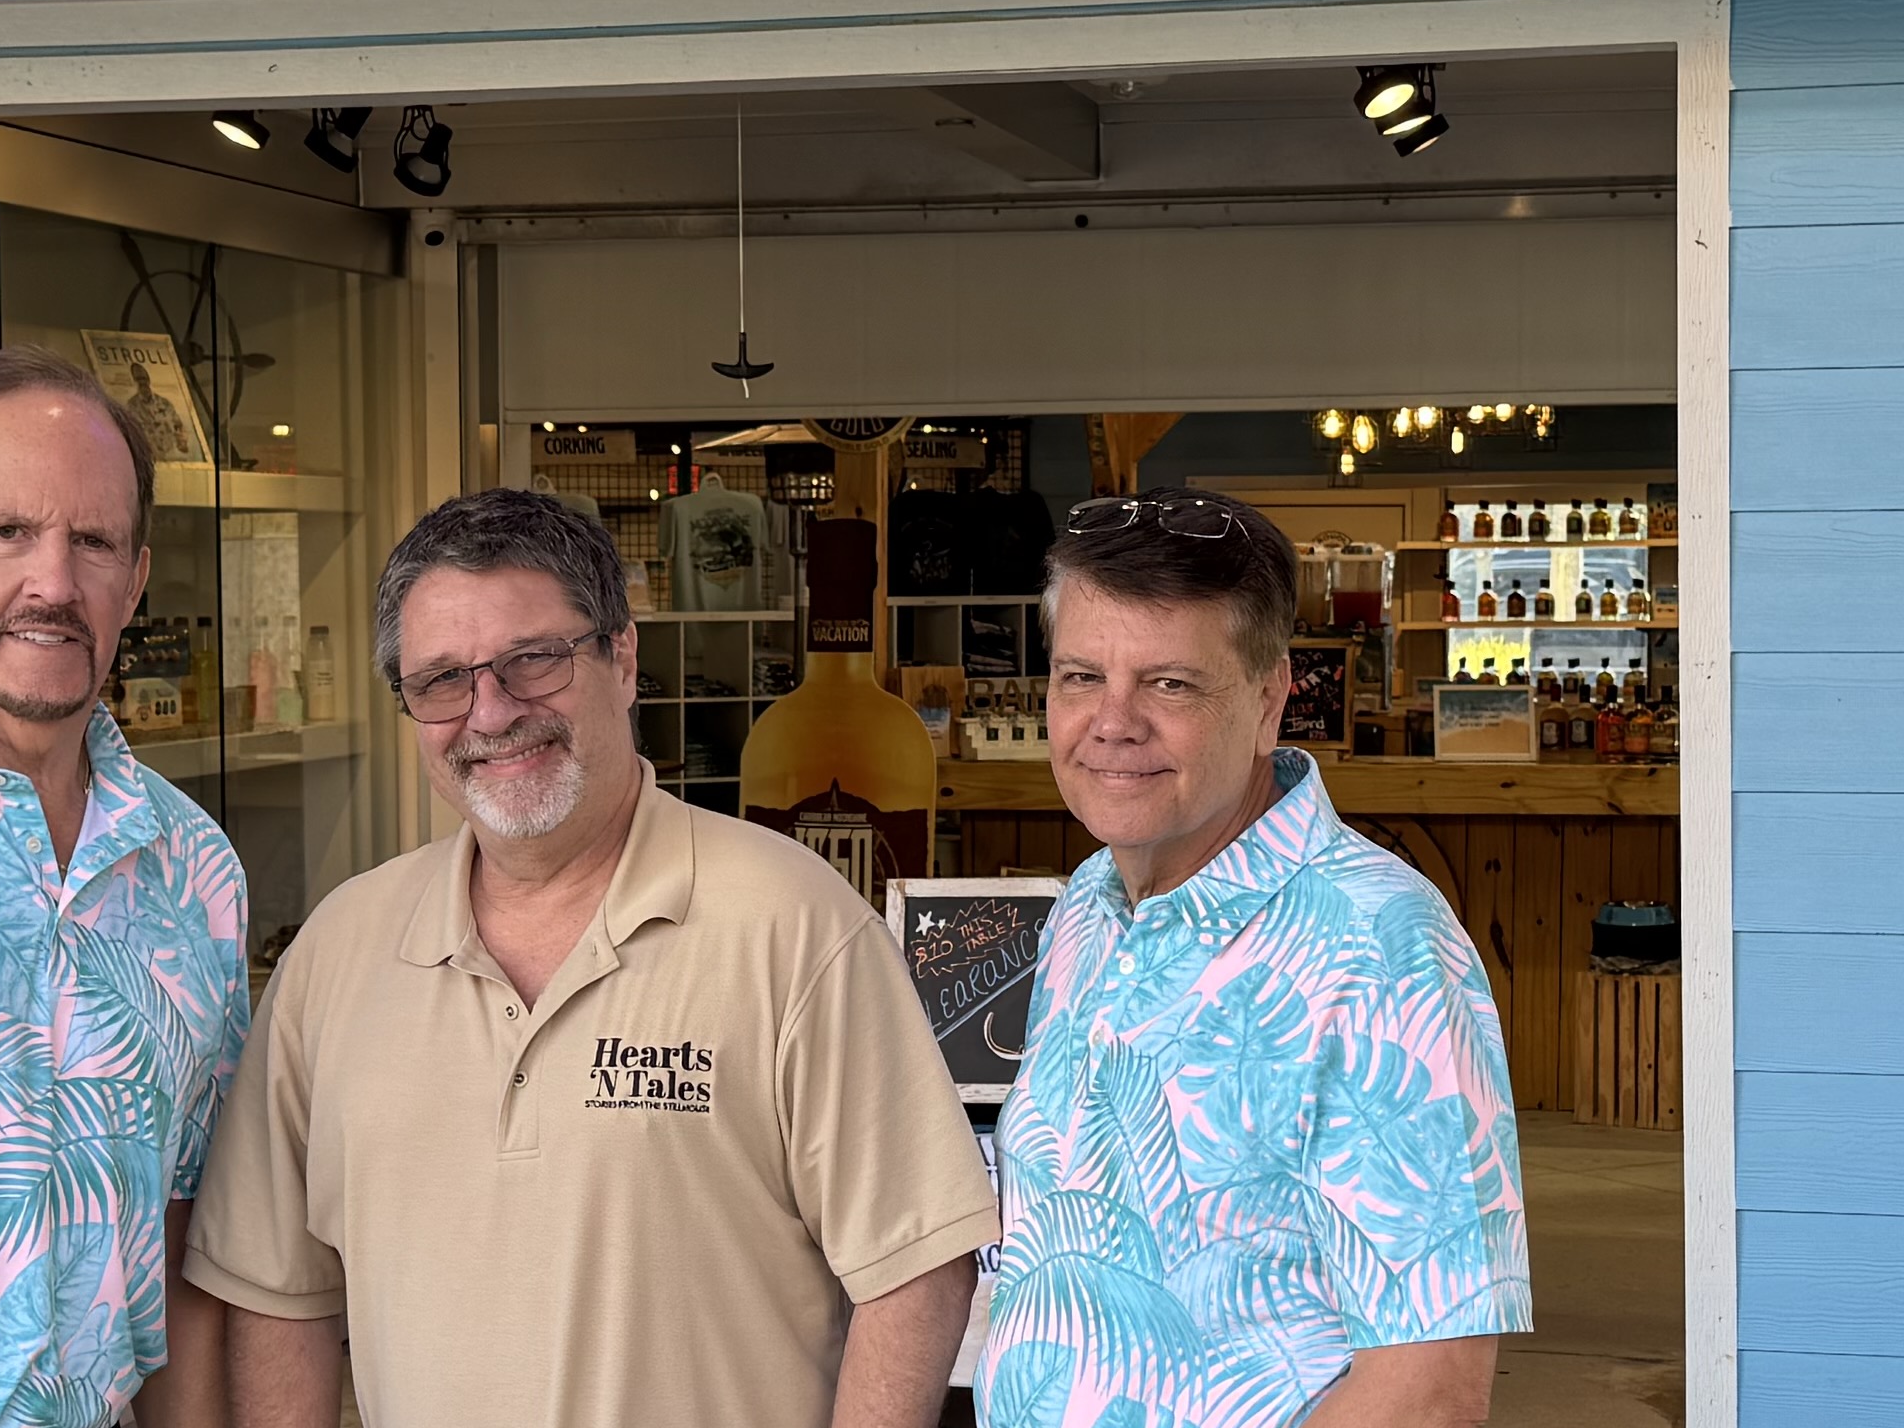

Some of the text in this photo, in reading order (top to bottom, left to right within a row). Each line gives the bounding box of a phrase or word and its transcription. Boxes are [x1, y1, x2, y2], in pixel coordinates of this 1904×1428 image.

[97, 345, 169, 366] STROLL
[544, 436, 606, 455] CORKING
[905, 441, 957, 459] SEALING
[812, 626, 870, 642] VACATION
[957, 914, 994, 938] THIS
[959, 921, 1007, 952] TABLE
[591, 1037, 713, 1072] Hearts
[625, 1070, 711, 1102] Tales
